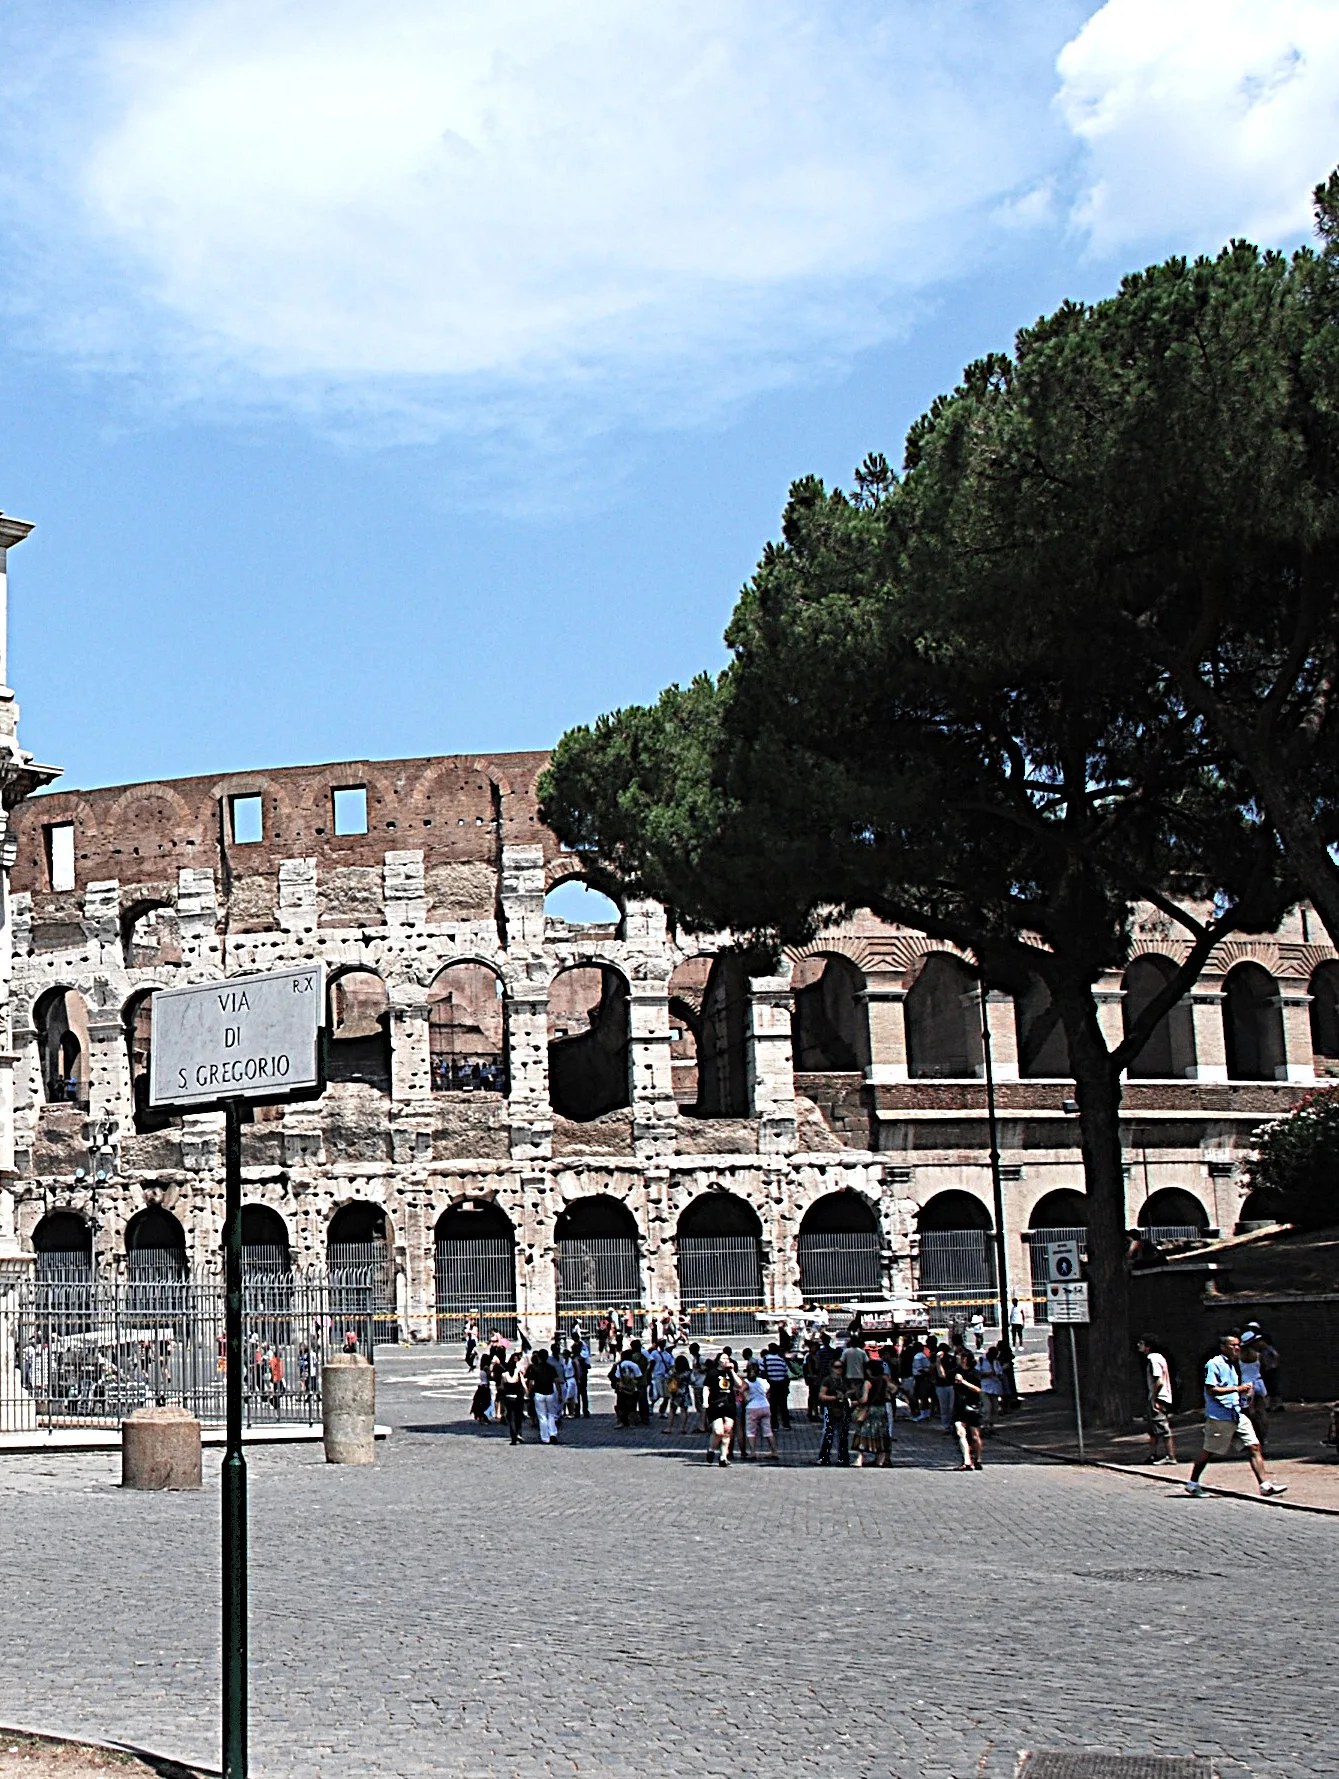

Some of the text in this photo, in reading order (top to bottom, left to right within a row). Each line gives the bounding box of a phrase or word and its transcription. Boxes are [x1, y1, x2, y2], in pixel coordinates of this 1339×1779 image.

[218, 990, 250, 1012] VIA
[224, 1026, 240, 1048] DI
[196, 1054, 290, 1087] GREGORIO
